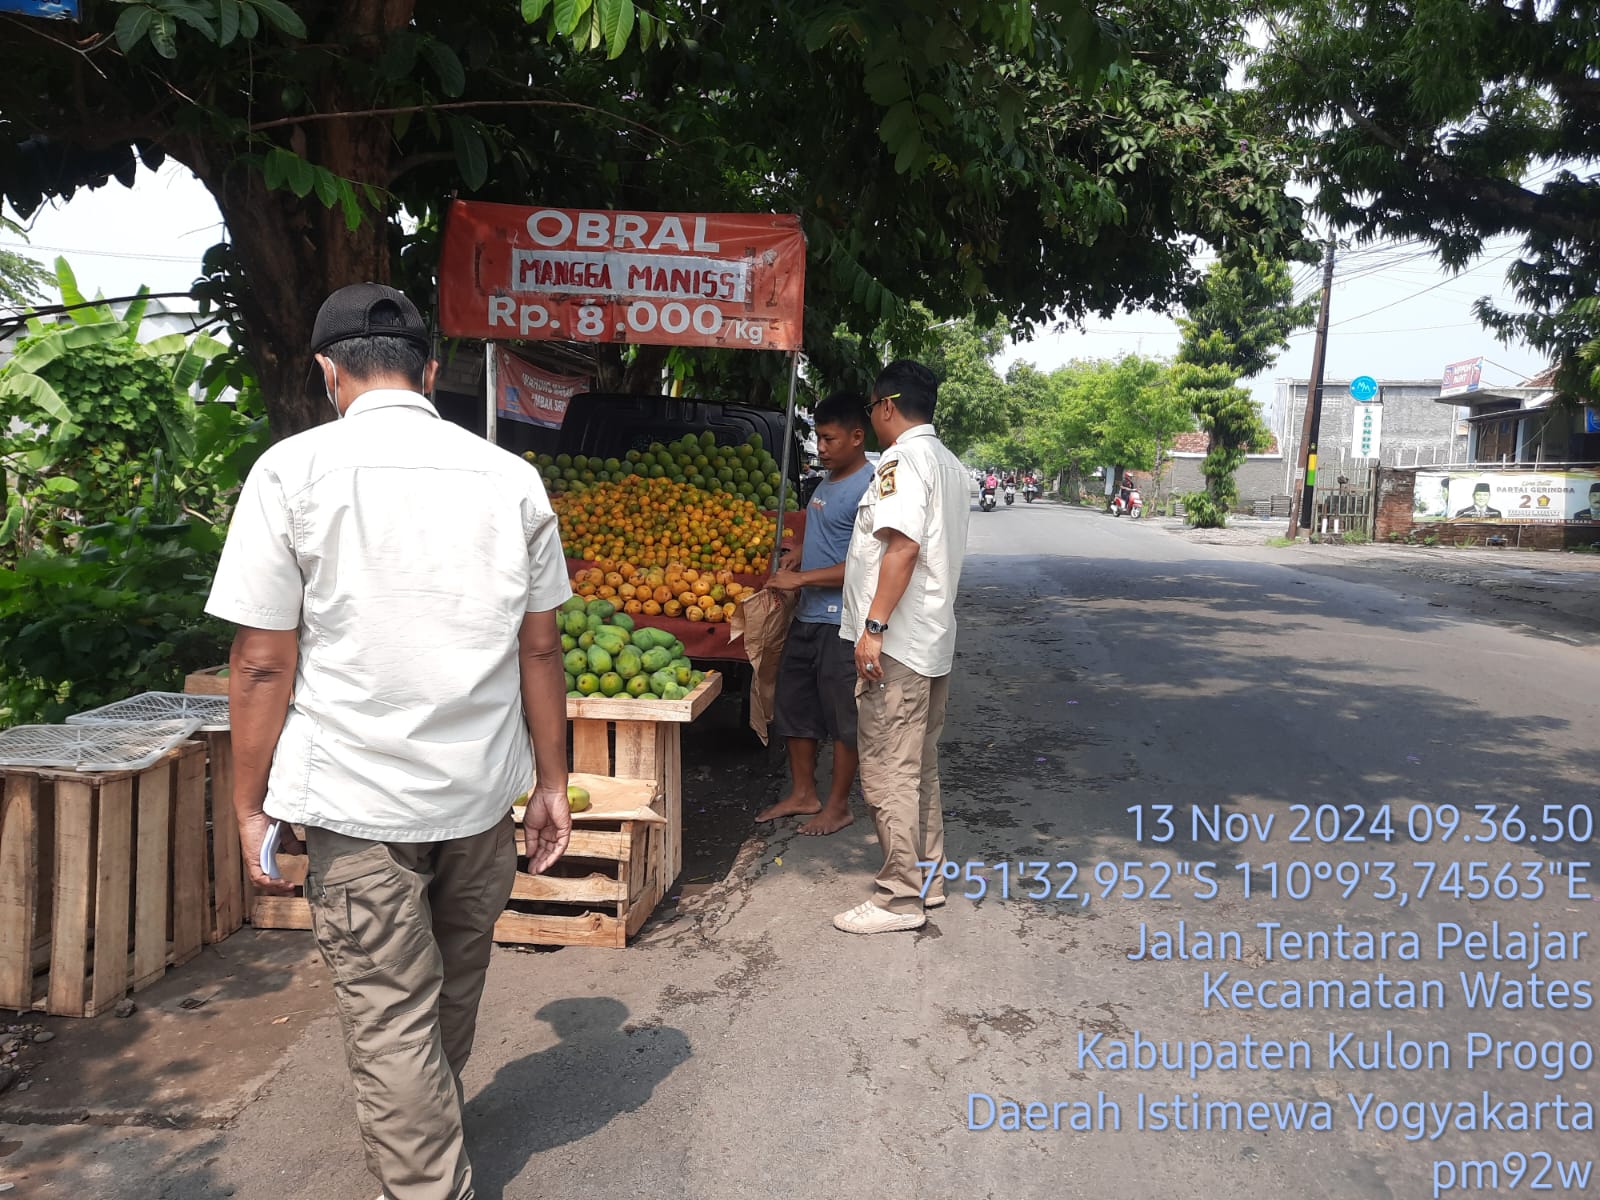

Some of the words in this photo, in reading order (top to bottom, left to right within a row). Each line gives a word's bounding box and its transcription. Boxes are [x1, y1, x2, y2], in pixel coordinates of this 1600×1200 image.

[526, 209, 720, 254] OBRAL
[519, 258, 612, 289] MANGGA
[627, 264, 736, 300] MANISS
[488, 295, 561, 335] Rp.
[1496, 486, 1528, 494] PARTAI
[1518, 494, 1532, 509] 2
